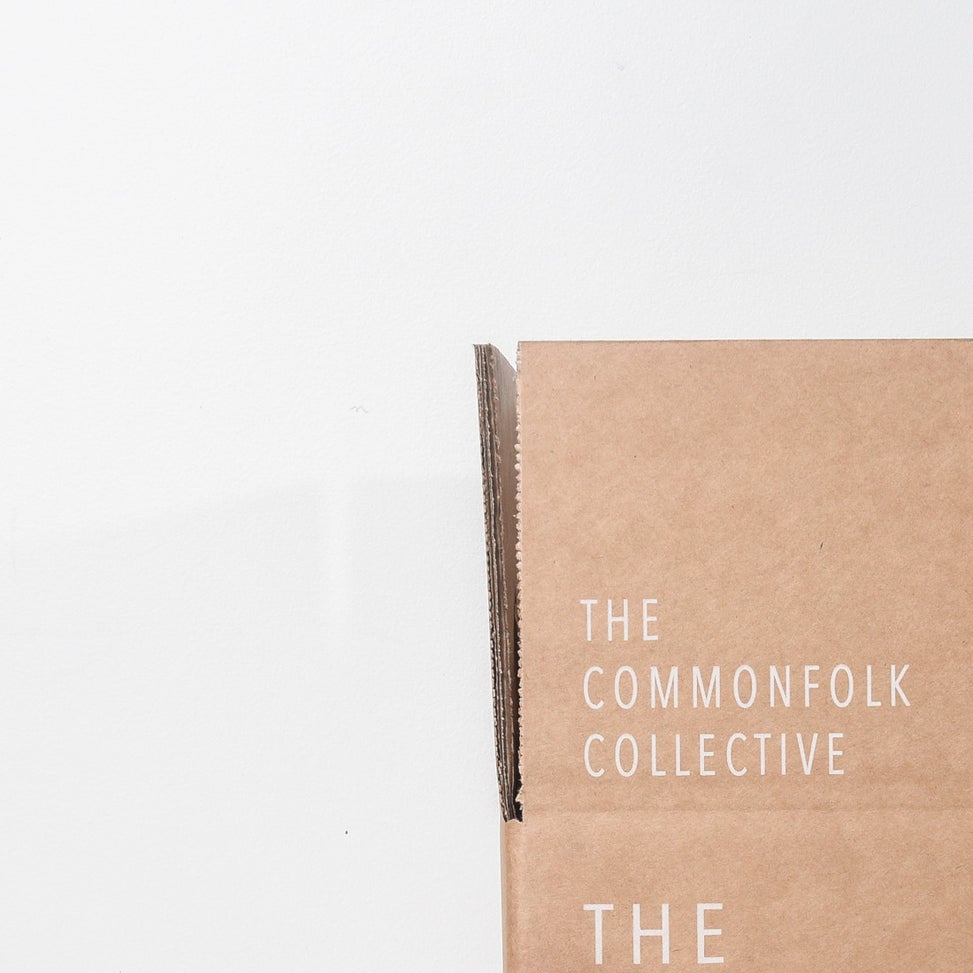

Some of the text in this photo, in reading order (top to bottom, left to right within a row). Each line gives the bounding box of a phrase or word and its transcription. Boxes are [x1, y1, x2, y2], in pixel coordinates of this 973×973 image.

[580, 598, 659, 641] THE
[583, 663, 911, 709] COMMONFOLK
[584, 732, 845, 777] COLLECTIVE
[583, 903, 724, 964] THE
